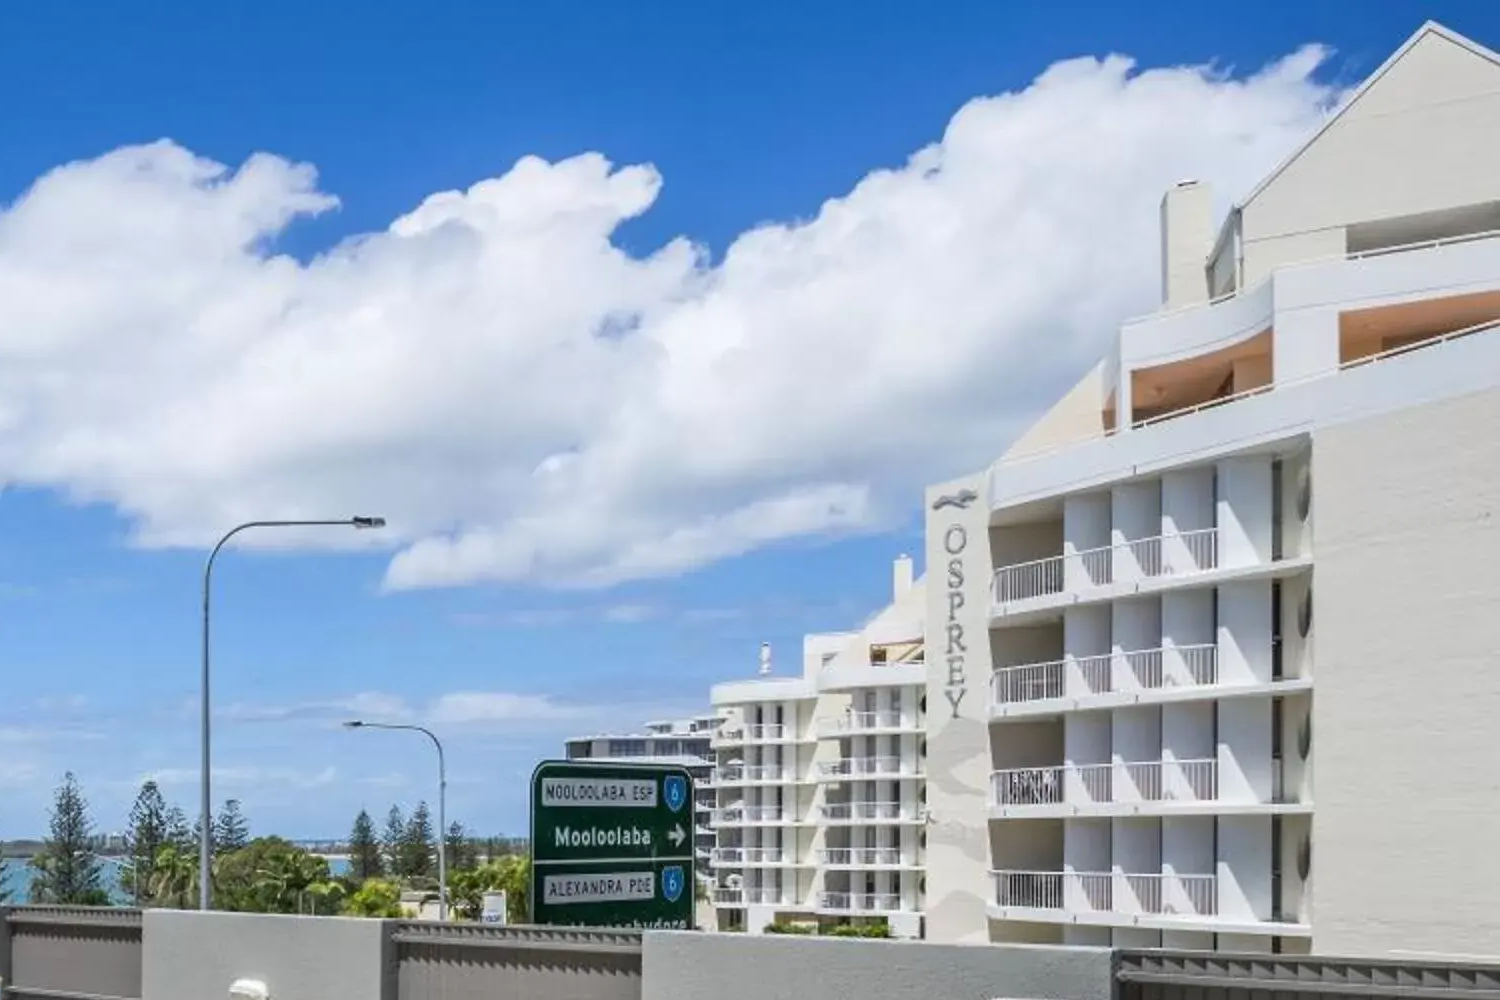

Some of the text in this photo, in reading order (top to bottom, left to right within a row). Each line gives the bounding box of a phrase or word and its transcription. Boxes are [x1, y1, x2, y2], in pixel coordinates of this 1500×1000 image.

[944, 524, 967, 719] OSPREY
[545, 784, 653, 801] MOOLOOLABA ESP
[671, 783, 679, 800] 6
[554, 826, 651, 846] Mooloolaba
[549, 877, 652, 897] ALEXANDRA PDE
[669, 873, 677, 890] 6
